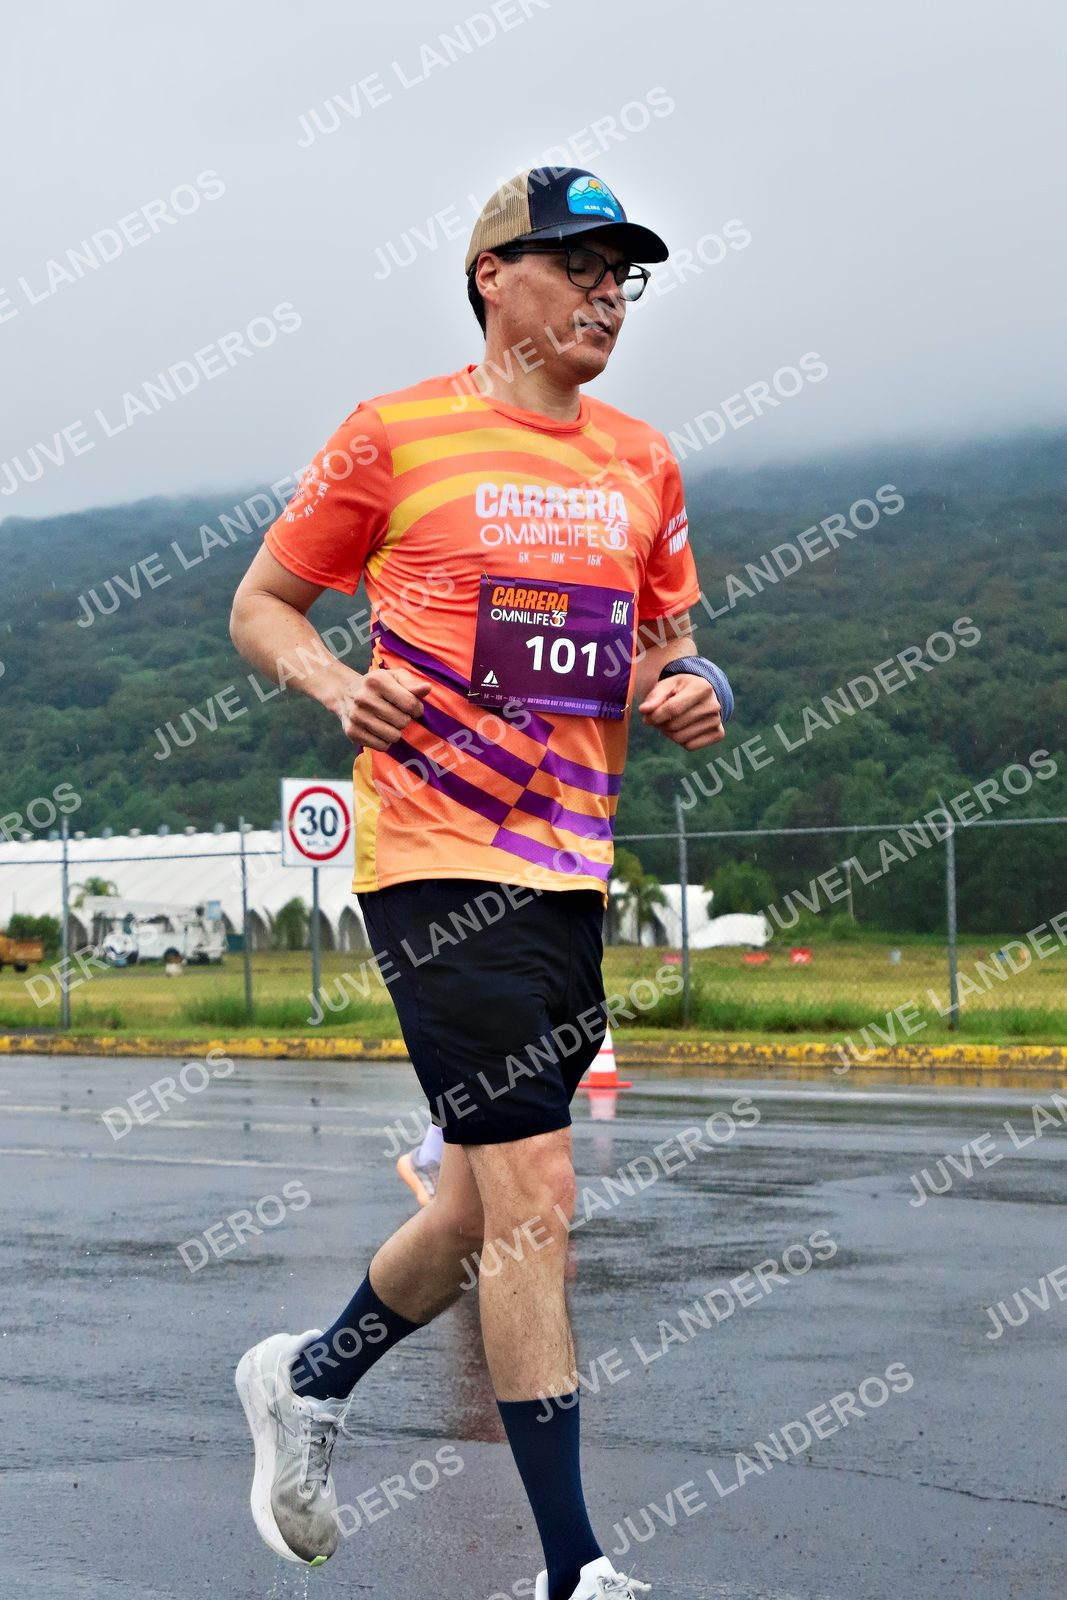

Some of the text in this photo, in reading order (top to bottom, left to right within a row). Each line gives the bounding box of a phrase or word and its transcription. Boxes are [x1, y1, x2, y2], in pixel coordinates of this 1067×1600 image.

[475, 482, 629, 522] CARRERA
[518, 552, 602, 566] 5K 10K 15K
[491, 586, 569, 611] CARRERA
[610, 600, 630, 626] 15K
[525, 635, 598, 677] 101
[300, 805, 338, 837] 30
